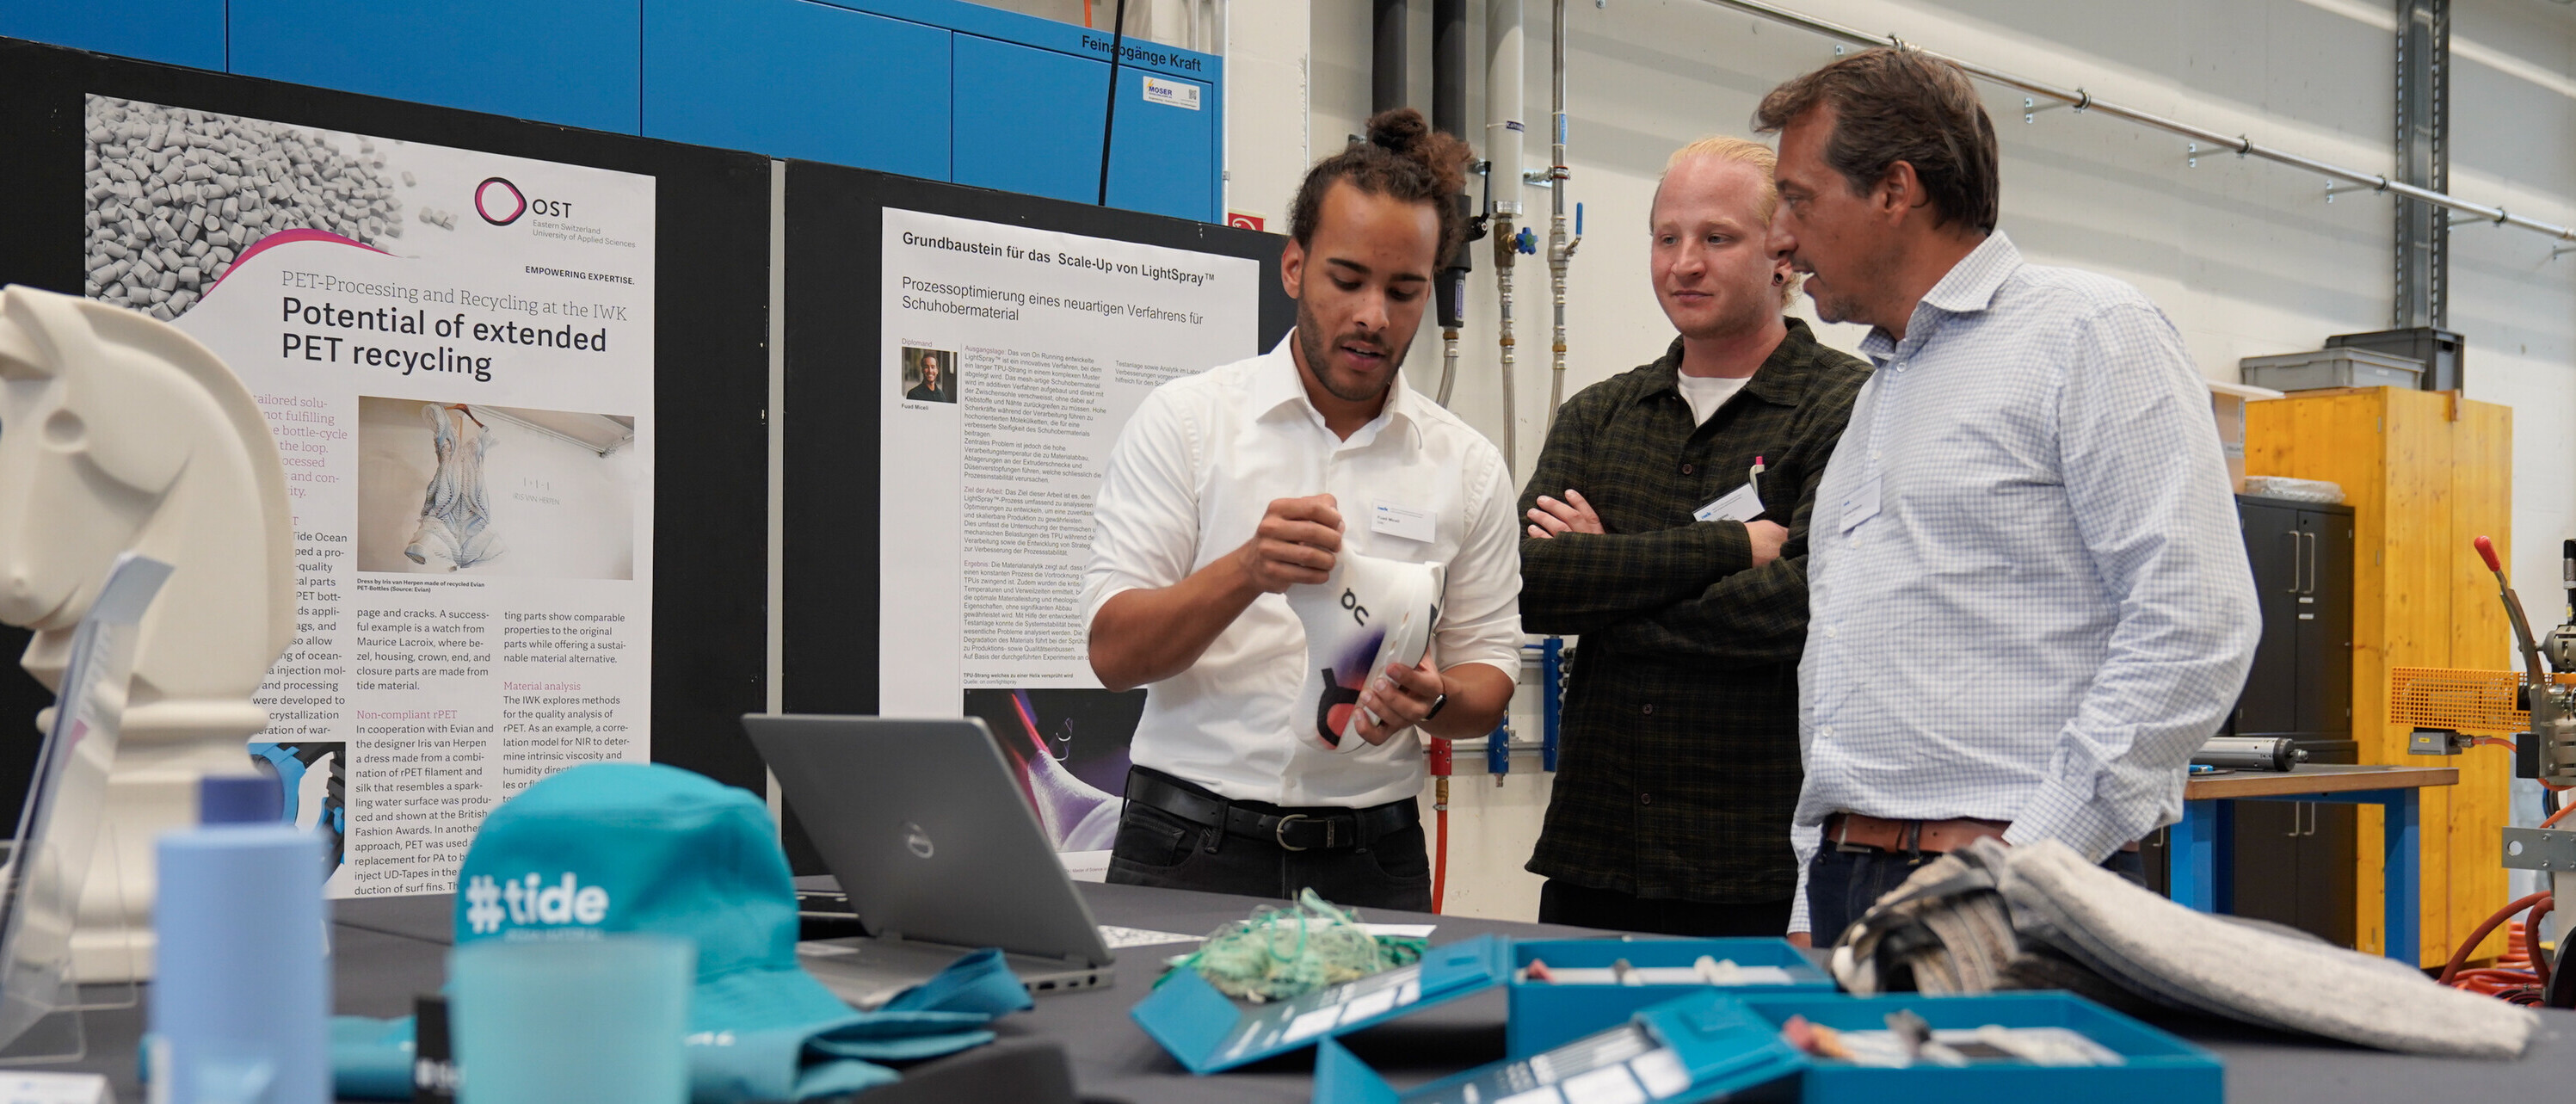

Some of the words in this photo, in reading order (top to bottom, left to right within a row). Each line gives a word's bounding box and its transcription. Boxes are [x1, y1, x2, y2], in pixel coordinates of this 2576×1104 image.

[1170, 53, 1202, 72] Kraft
[1149, 86, 1173, 96] MOSER
[533, 199, 571, 218] OST
[533, 219, 559, 231] Eastern
[561, 223, 601, 234] Switzerland
[533, 229, 568, 241] University
[577, 234, 604, 244] Applied
[605, 237, 635, 248] Sciences
[903, 232, 1002, 256] Grundbaustein
[1007, 245, 1025, 259] für
[1028, 250, 1051, 262] das
[1058, 253, 1112, 273] Scale-Up
[1116, 264, 1137, 274] von
[526, 266, 586, 279] EMPOWERING
[589, 273, 635, 285] EXPERTISE.
[282, 271, 418, 303] PET-Processing
[423, 288, 454, 303] and
[460, 290, 538, 316] Recycling
[542, 302, 558, 314] at
[563, 301, 588, 317] the
[594, 305, 627, 321] IWK
[903, 277, 1025, 309] Prozessoptimierung
[1029, 293, 1060, 307] eines
[1064, 299, 1124, 316] neuartigen
[1127, 305, 1186, 322] Verfahrens
[1190, 311, 1203, 324] für
[903, 296, 1019, 320] Schuhobermaterial
[284, 298, 424, 334] Potential
[435, 313, 465, 338] of
[473, 322, 606, 351] extended
[902, 338, 933, 349] Diplomand
[283, 333, 343, 361] PET
[354, 347, 491, 381] recycling
[287, 410, 335, 426] fulfilling
[280, 441, 299, 454] the
[302, 441, 329, 455] loop.
[357, 609, 380, 619] page
[384, 608, 401, 617] and
[404, 609, 437, 618] cracks.
[440, 609, 447, 618] A
[504, 611, 522, 622] ting
[524, 613, 546, 621] parts
[574, 614, 625, 622] comparable
[357, 622, 368, 631] ful
[372, 624, 412, 633] example
[415, 623, 422, 632] is
[463, 624, 484, 633] from
[504, 626, 550, 635] properties
[563, 626, 577, 635] the
[580, 627, 612, 638] original
[357, 637, 397, 646] Maurice
[399, 638, 435, 647] Lacroix,
[438, 638, 466, 647] where
[469, 638, 484, 647] be-
[504, 640, 527, 650] parts
[554, 640, 589, 651] offering
[597, 641, 626, 650] sustai-
[357, 651, 372, 661] zel,
[375, 652, 416, 663] housing,
[452, 653, 471, 662] end,
[473, 653, 490, 662] and
[531, 654, 566, 663] material
[356, 667, 392, 675] closure
[395, 668, 419, 677] parts
[467, 667, 488, 675] from
[262, 680, 280, 689] and
[284, 682, 338, 692] processing
[356, 681, 375, 690] tide
[378, 682, 419, 690] material.
[504, 682, 542, 690] Material
[545, 682, 581, 692] analysis
[253, 694, 277, 705] were
[280, 695, 332, 706] developed
[503, 695, 520, 704] The
[543, 696, 580, 706] explores
[357, 710, 430, 720] Non-compliant
[434, 710, 458, 719] rPET
[367, 725, 425, 735] cooperation
[427, 725, 447, 733] with
[450, 725, 474, 733] Evian
[477, 725, 494, 733] and
[356, 739, 372, 749] the
[374, 739, 416, 750] designer
[418, 739, 432, 748] Iris
[453, 739, 486, 749] Herpen
[364, 755, 390, 763] dress
[392, 754, 418, 762] made
[421, 753, 442, 762] from
[453, 753, 484, 762] combi-
[466, 873, 610, 935] #tide
